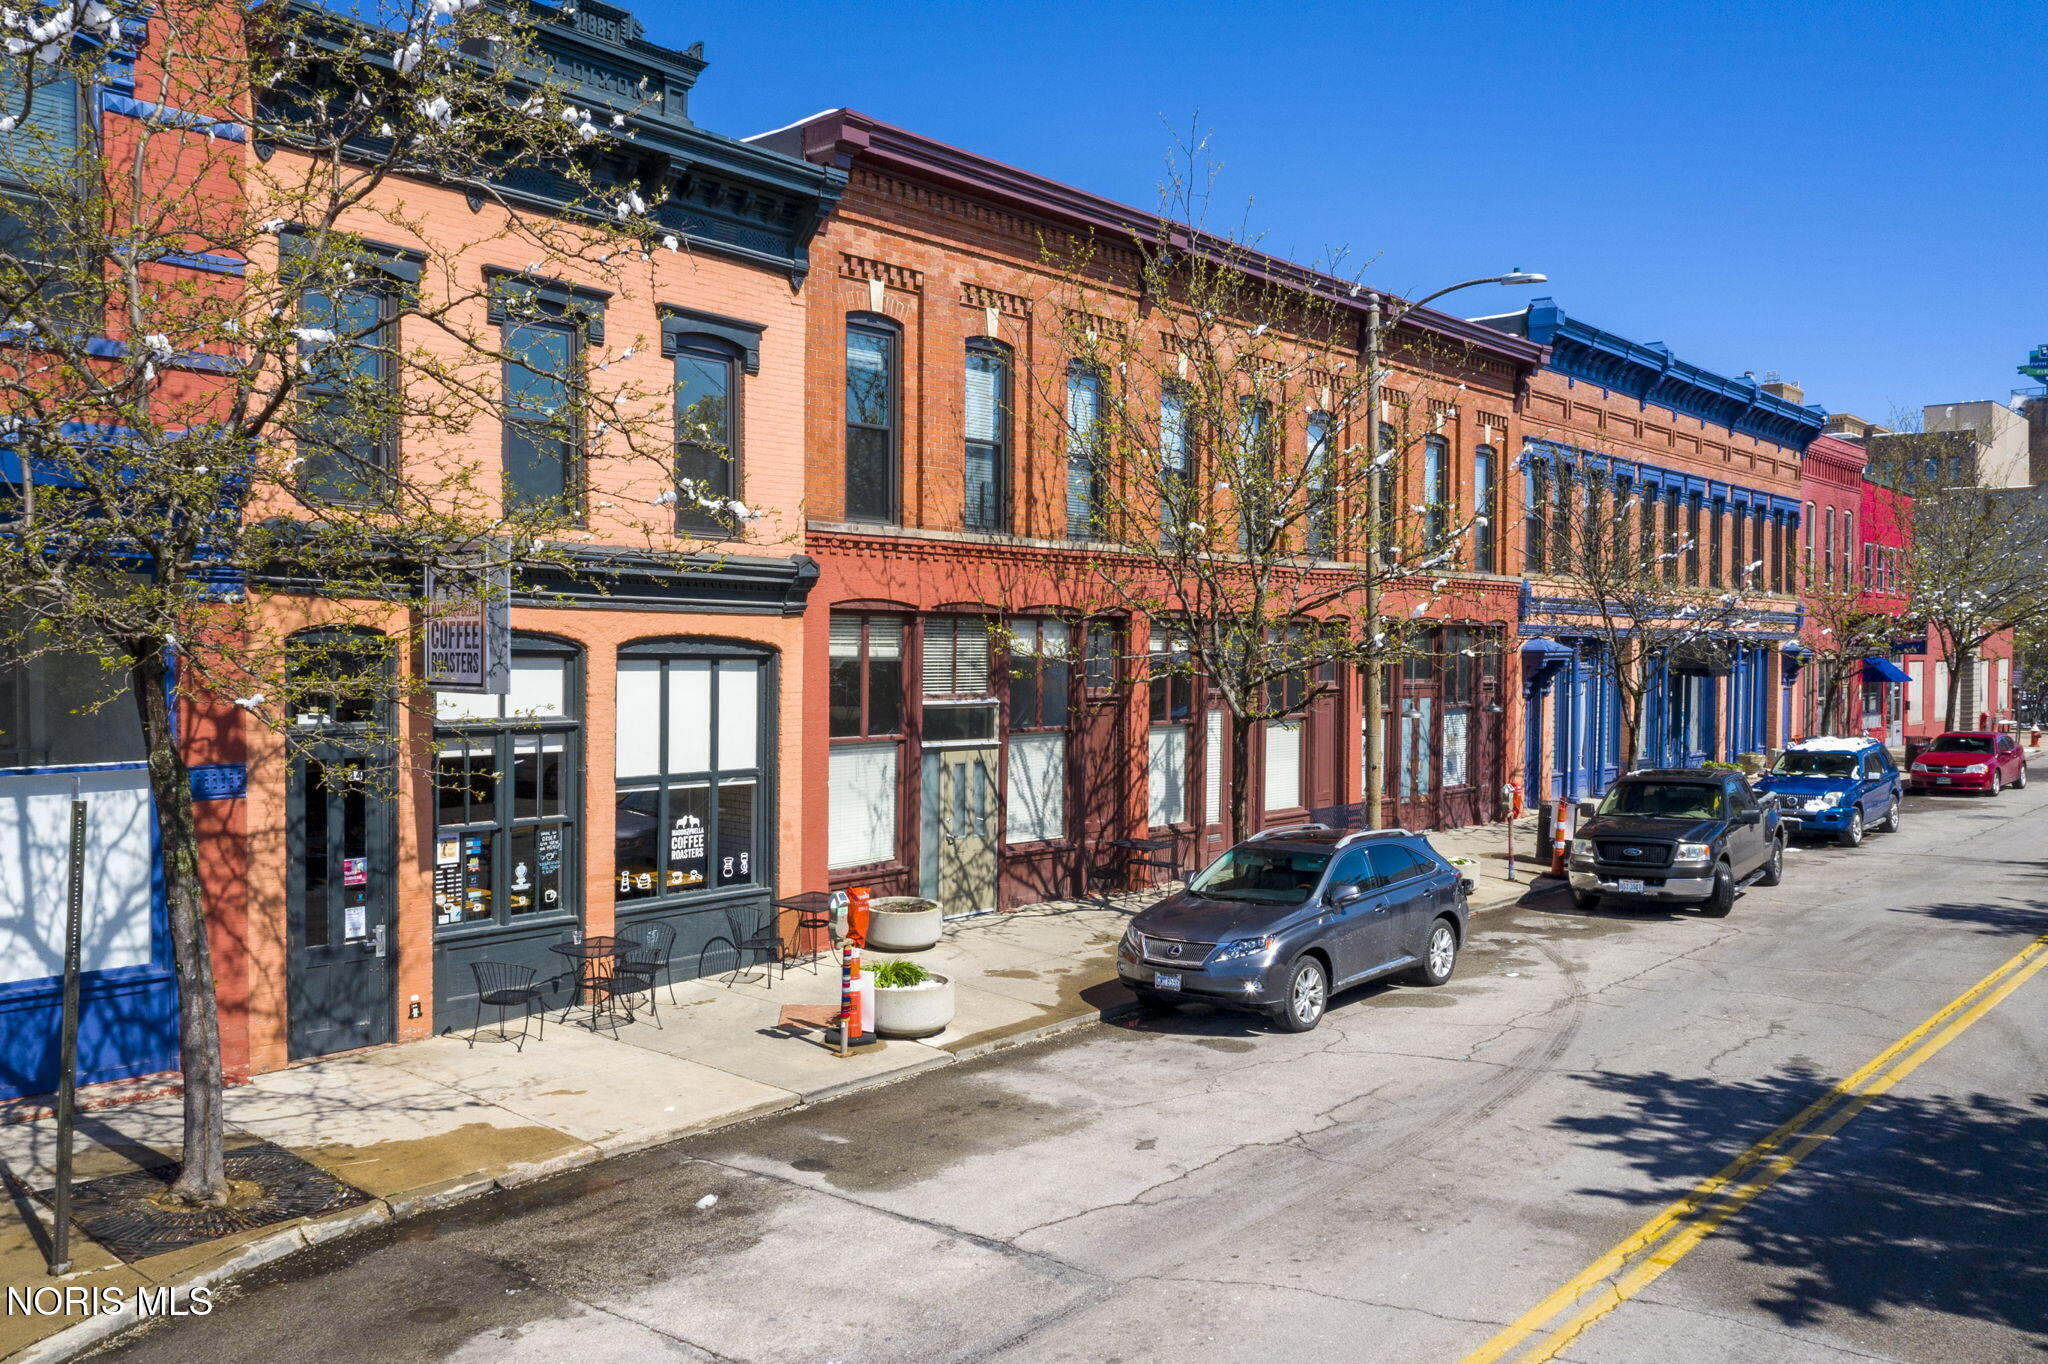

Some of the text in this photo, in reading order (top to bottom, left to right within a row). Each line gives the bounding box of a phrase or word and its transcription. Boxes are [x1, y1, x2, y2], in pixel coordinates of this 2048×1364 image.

[580, 14, 616, 39] 1885
[570, 60, 644, 101] DIXON
[431, 620, 480, 649] COFFEE
[431, 652, 479, 674] ROASTERS
[671, 834, 704, 850] COFFEE
[671, 847, 704, 860] ROASTERS
